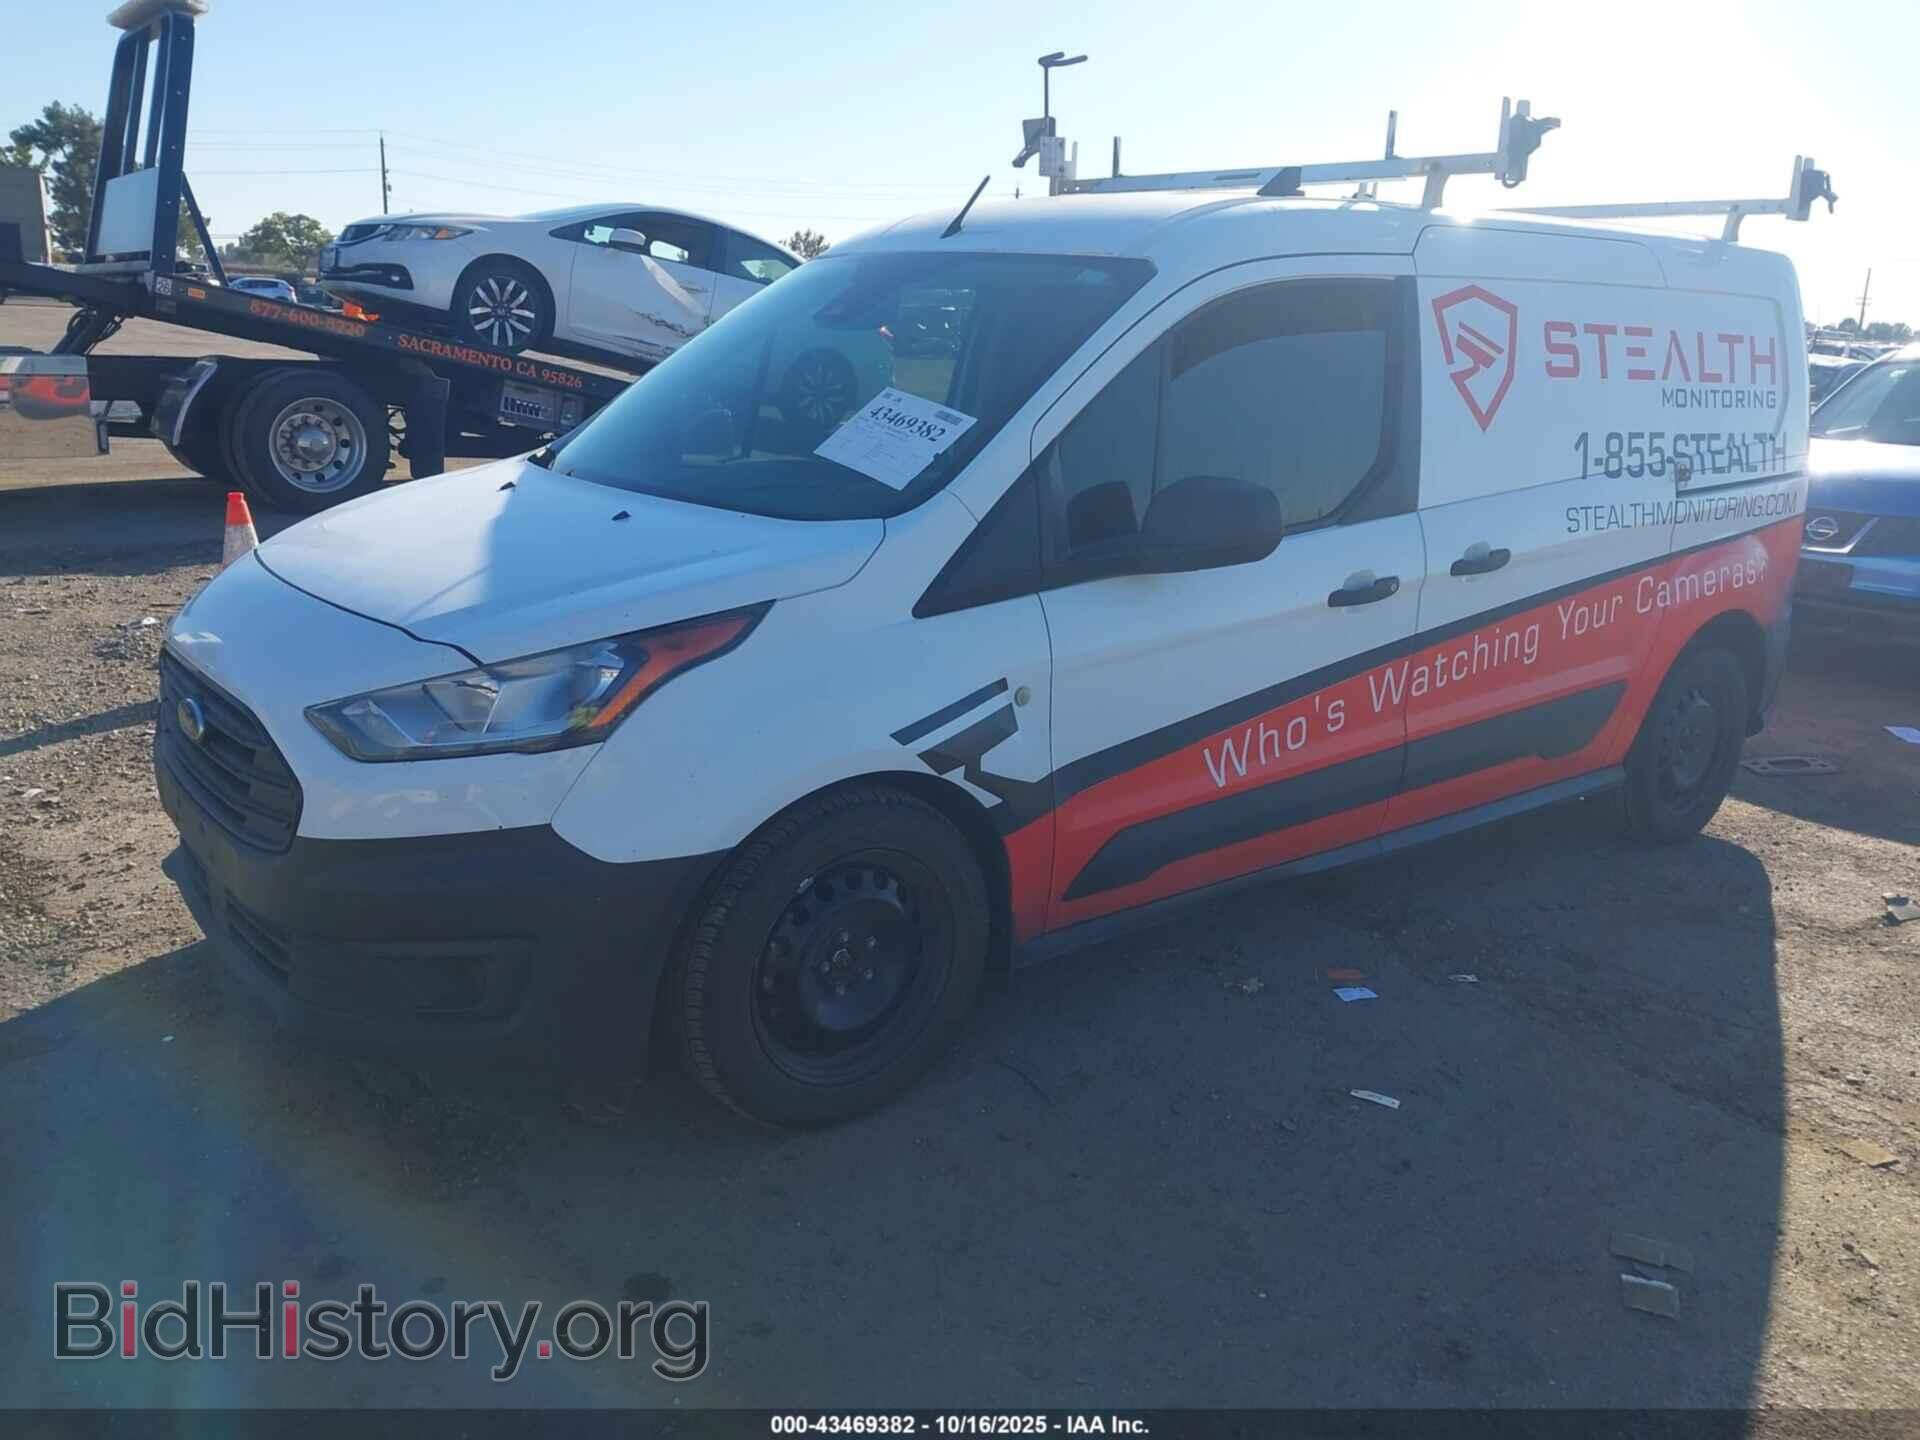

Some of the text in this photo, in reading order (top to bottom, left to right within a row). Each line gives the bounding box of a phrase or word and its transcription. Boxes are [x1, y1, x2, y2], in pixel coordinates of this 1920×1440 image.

[398, 334, 582, 389] SACRAMENTO CA 95826
[1543, 320, 1776, 385] STEALTH
[1661, 387, 1776, 409] MONITORING
[870, 405, 946, 442] 43469382
[1574, 431, 1787, 481] 1-855-STEALTH
[1566, 492, 1799, 534] STEALTHMONITORING.COM
[1203, 697, 1345, 789] Who's
[1368, 622, 1541, 714] Watching
[1557, 593, 1624, 640] Your
